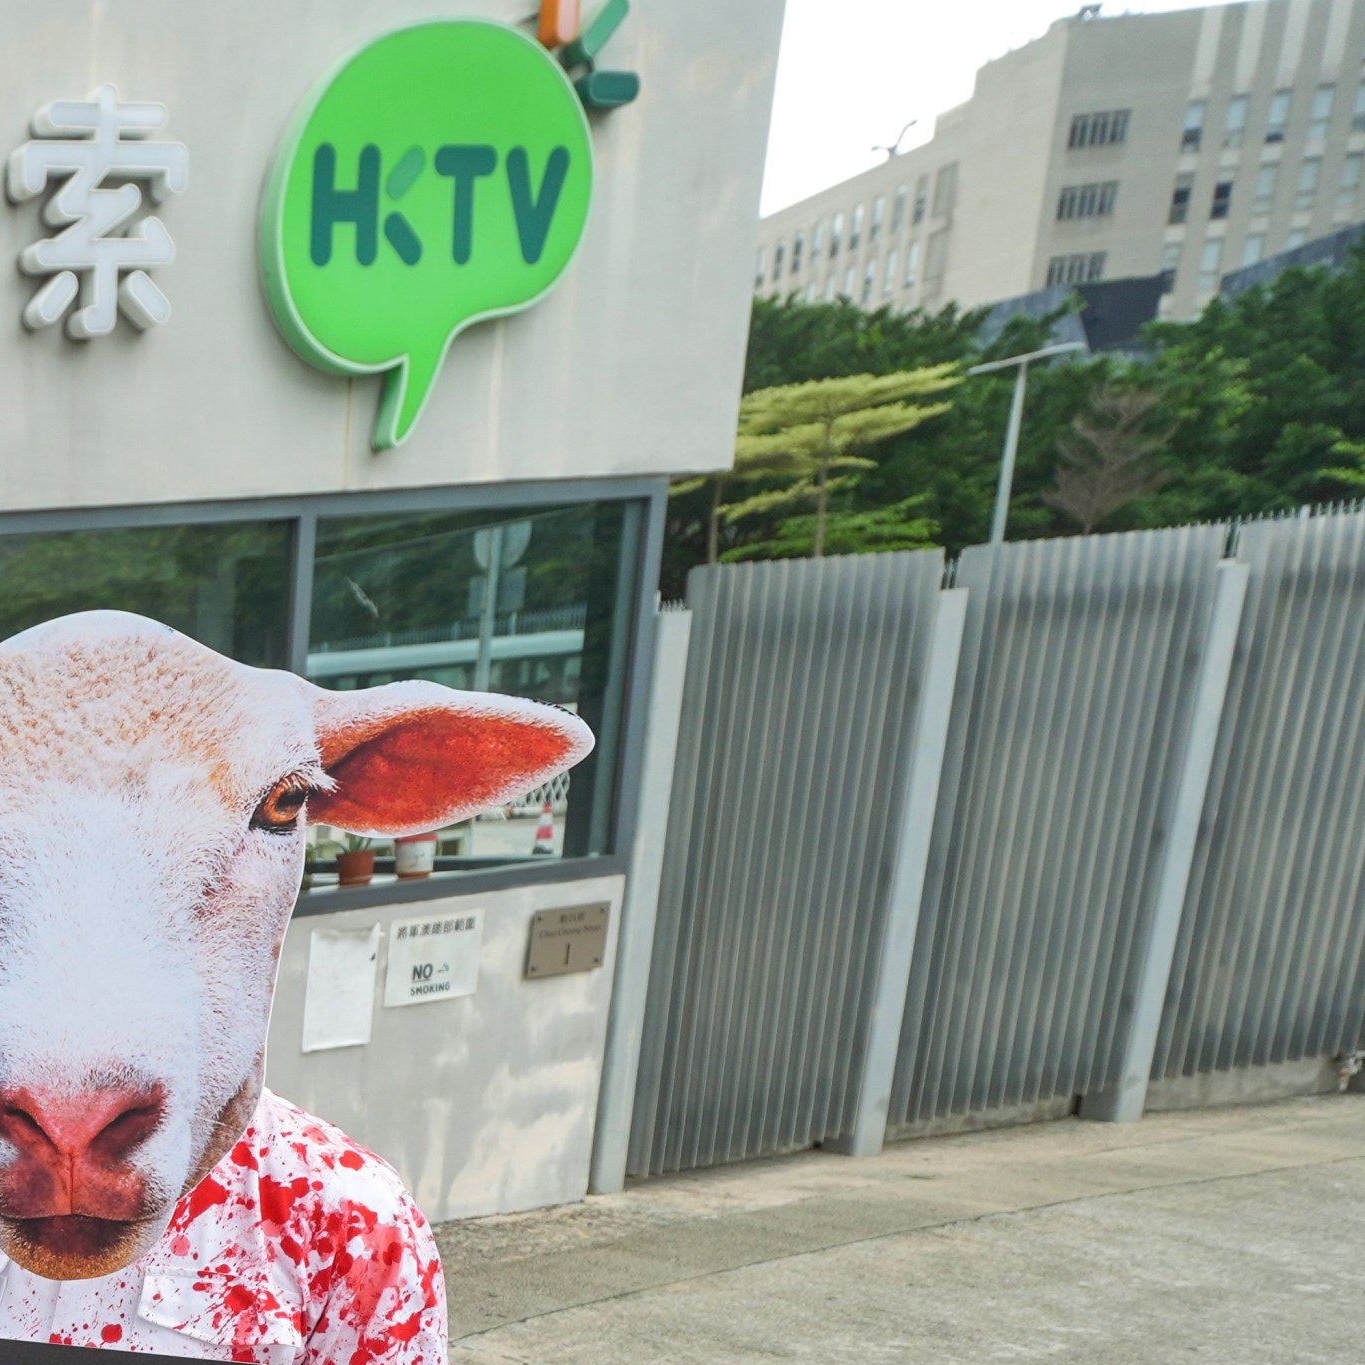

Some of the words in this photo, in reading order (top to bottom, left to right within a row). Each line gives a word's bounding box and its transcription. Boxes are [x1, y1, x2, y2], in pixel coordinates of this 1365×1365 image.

[310, 142, 570, 267] HKTV
[412, 963, 433, 980] NO
[410, 981, 451, 996] SMOKING
